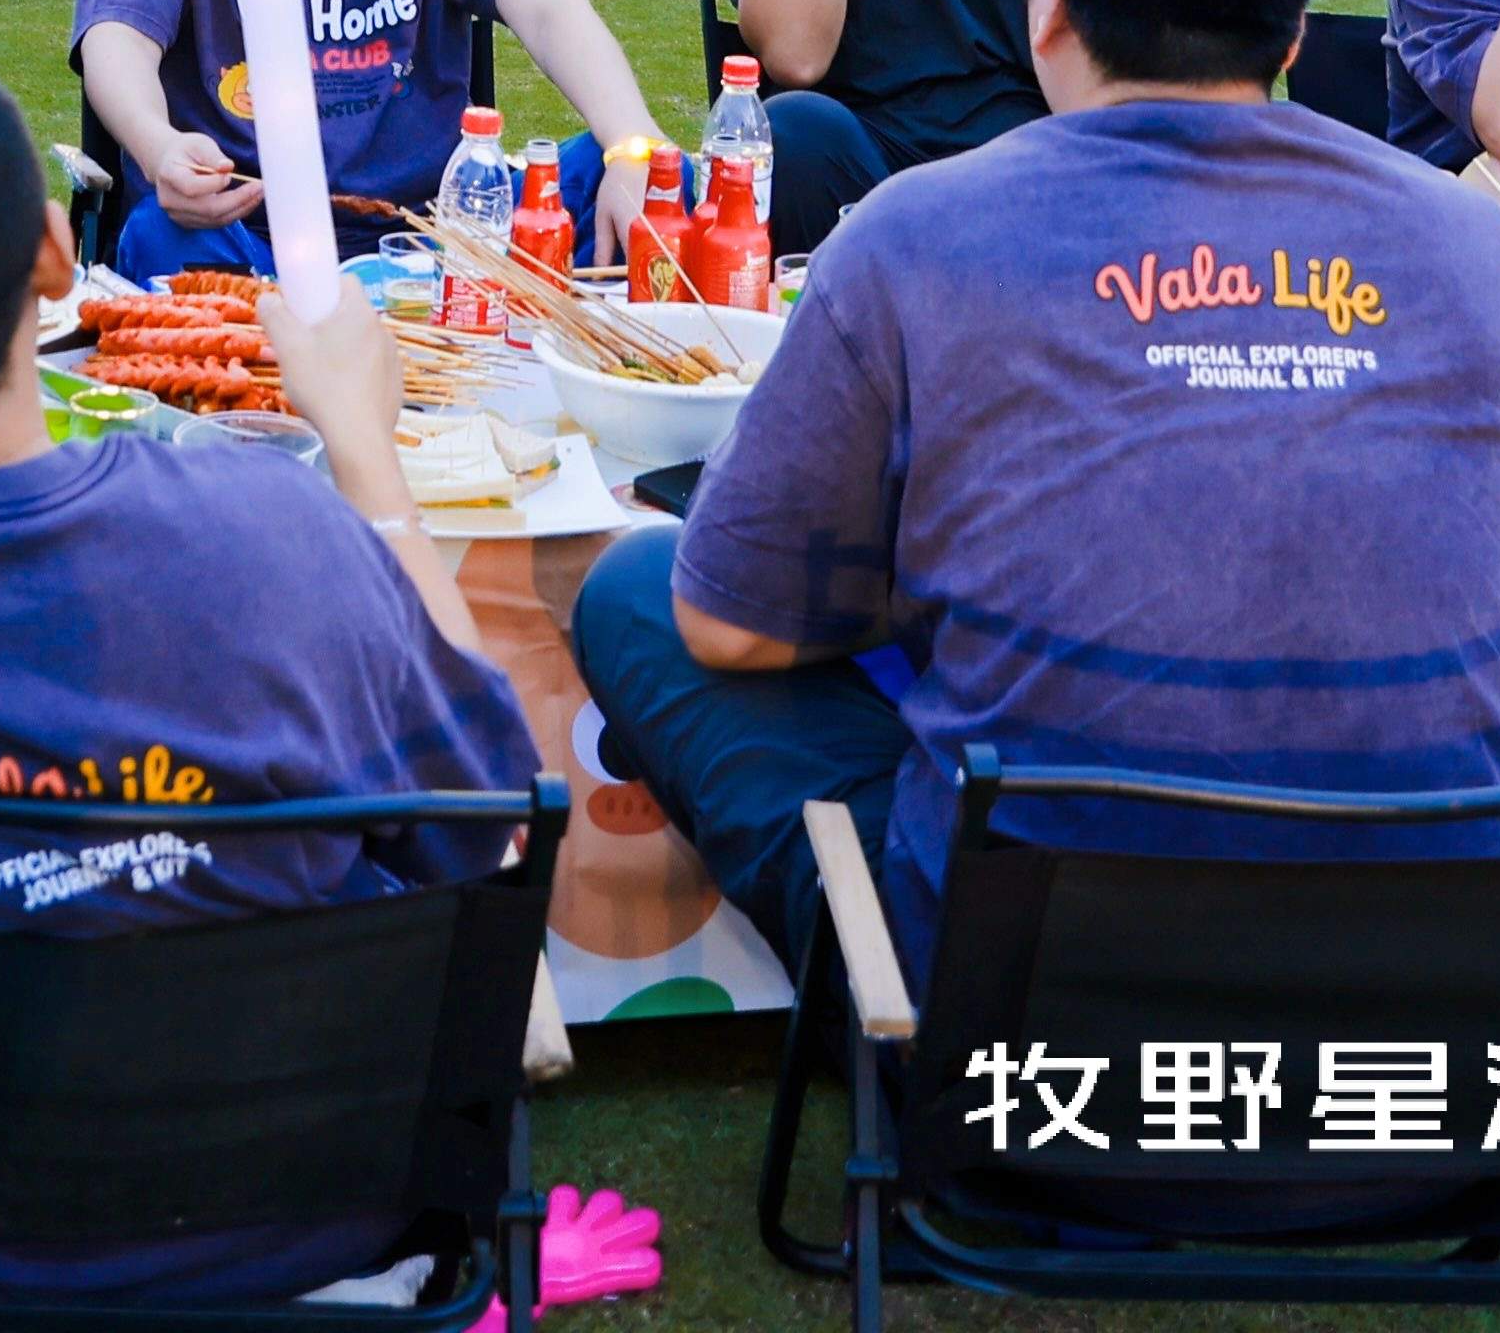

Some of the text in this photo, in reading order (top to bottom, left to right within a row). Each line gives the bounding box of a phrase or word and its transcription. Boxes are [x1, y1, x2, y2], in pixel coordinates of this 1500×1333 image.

[322, 38, 392, 71] CLUB
[1095, 243, 1388, 337] Vala Life
[1145, 344, 1378, 372] OFFICIAL EXPLORER'S
[1186, 366, 1348, 390] JOURNAL & KIT
